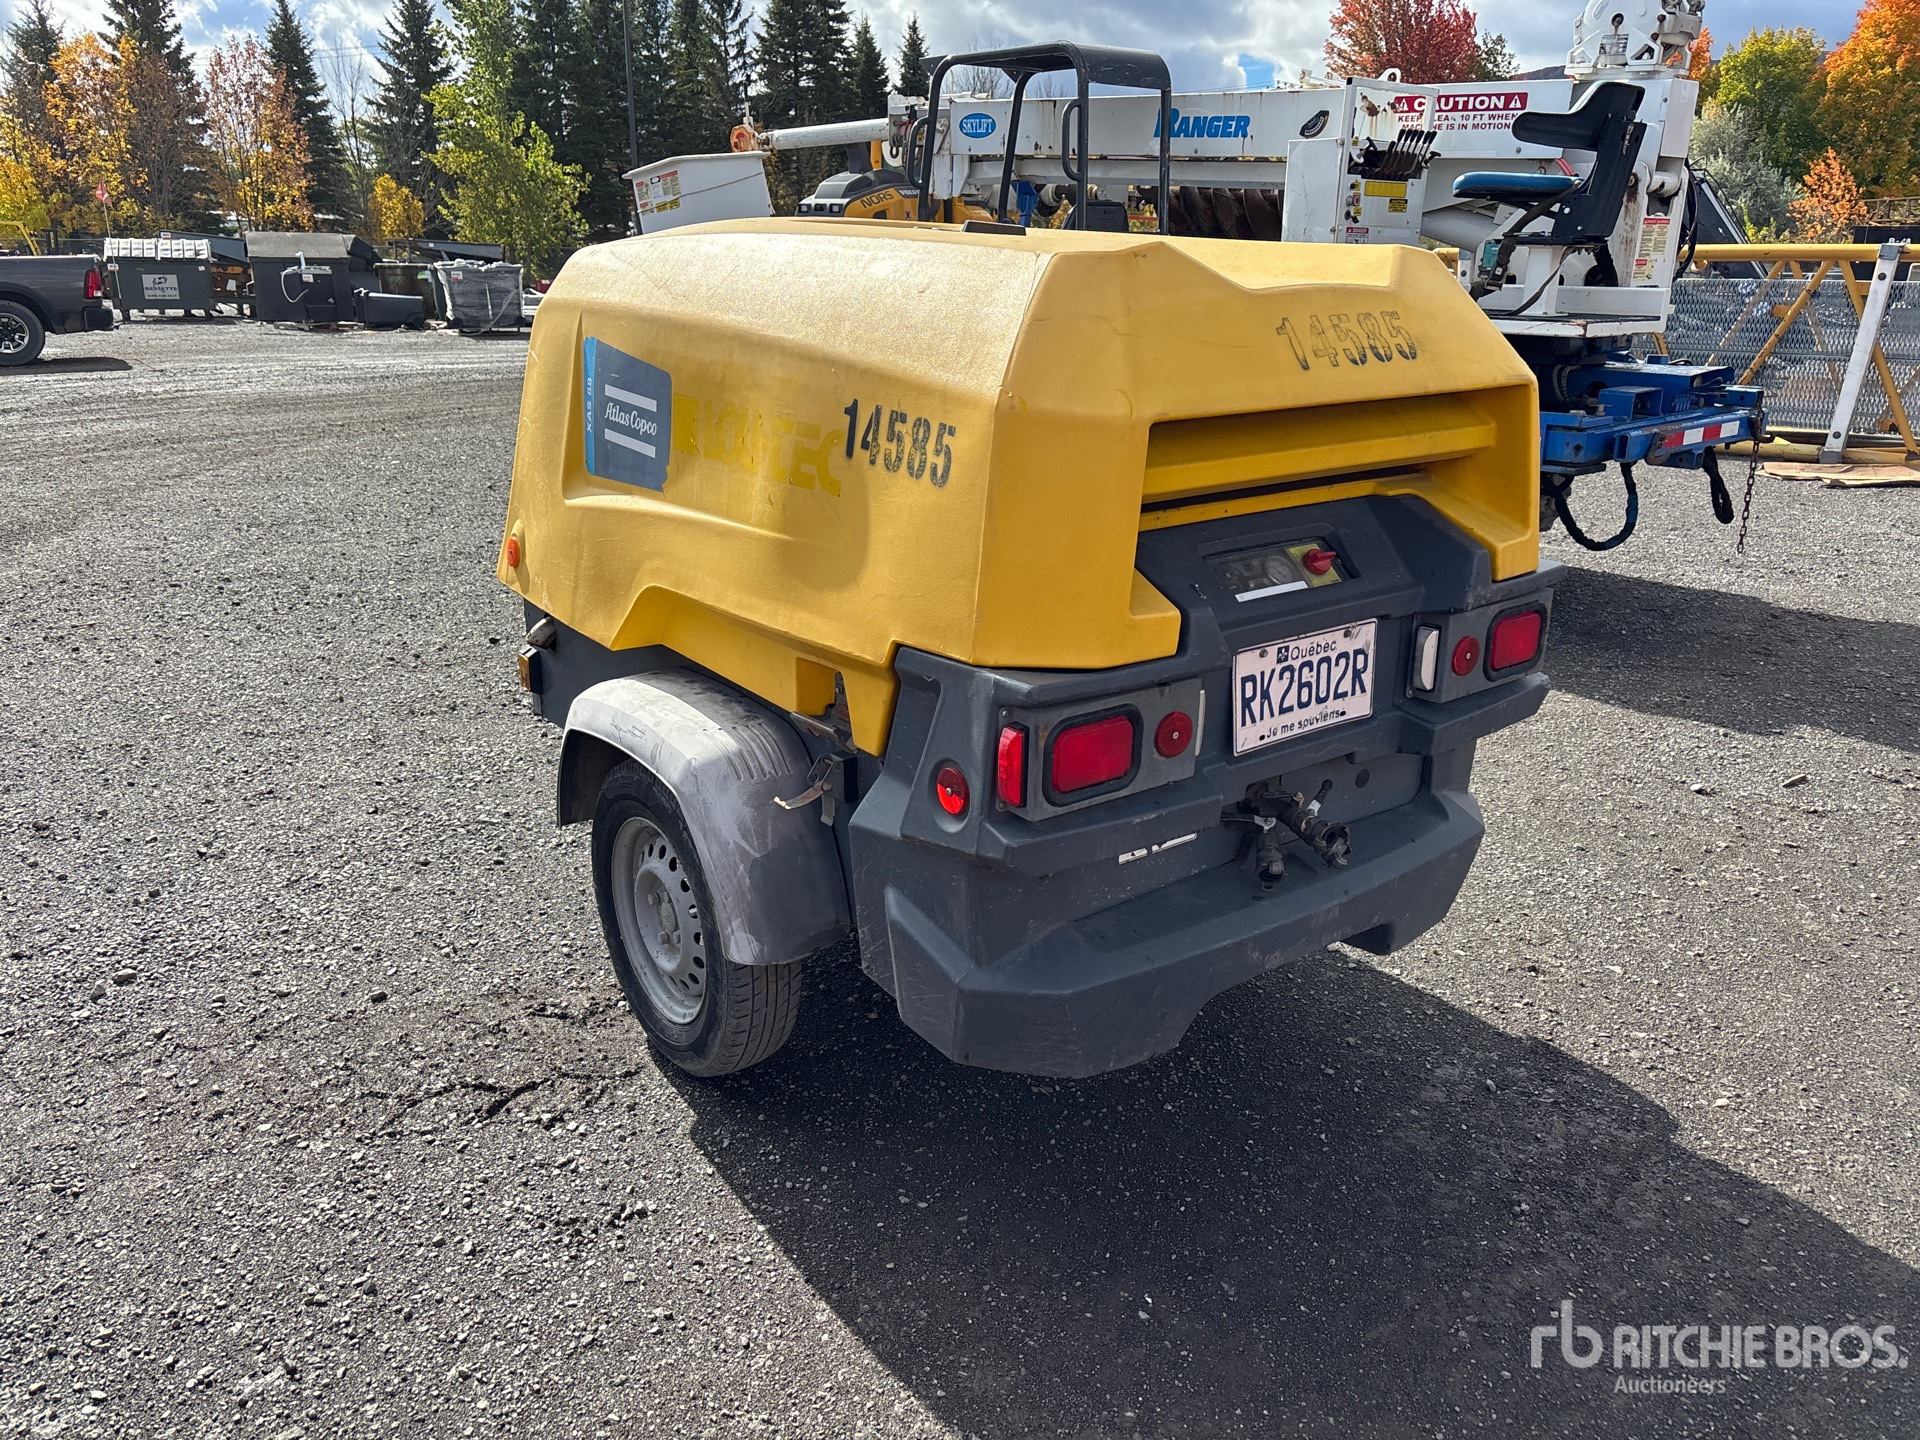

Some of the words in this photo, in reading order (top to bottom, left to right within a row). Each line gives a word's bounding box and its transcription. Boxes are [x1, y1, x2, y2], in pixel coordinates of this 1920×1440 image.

[1413, 95, 1505, 112] CUTION
[962, 119, 993, 133] SKYLIFT
[1153, 107, 1251, 138] RANGER
[1471, 121, 1511, 130] MOTION
[1472, 113, 1485, 121] FT
[860, 190, 894, 209] NORS
[1276, 311, 1417, 371] 14585
[604, 402, 630, 427] Atlas
[630, 410, 658, 436] Copco
[844, 398, 956, 488] 14585
[1290, 640, 1337, 661] Québec
[1240, 648, 1369, 728] RK2602R
[1266, 727, 1278, 739] Je
[1281, 722, 1295, 734] me
[1298, 708, 1340, 731] souviens
